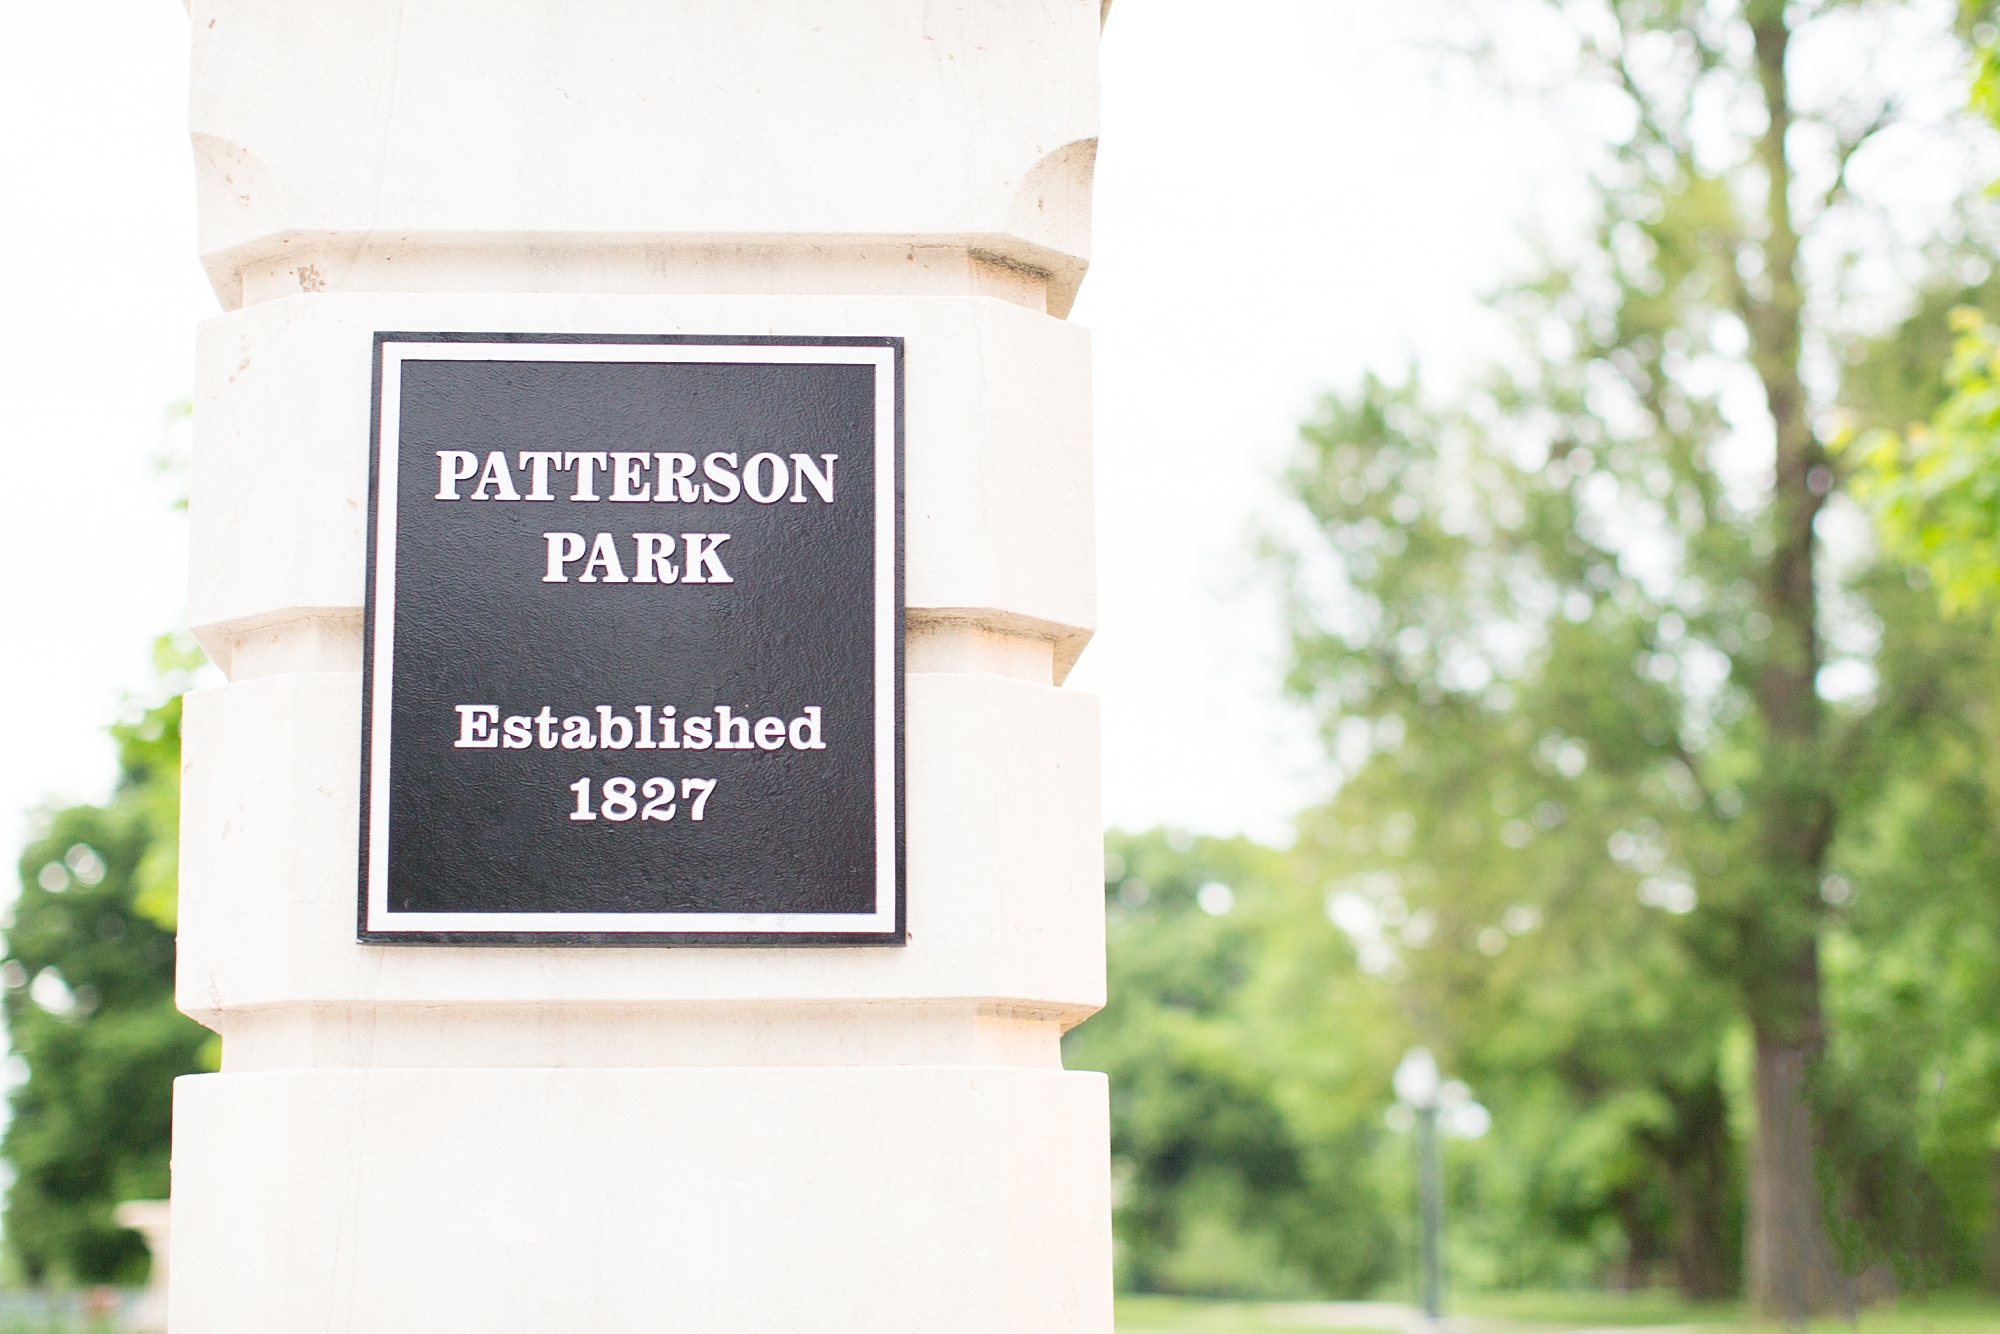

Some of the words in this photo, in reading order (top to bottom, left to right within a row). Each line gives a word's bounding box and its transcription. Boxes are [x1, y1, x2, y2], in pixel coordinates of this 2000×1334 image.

[435, 450, 838, 503] PATTERSON
[542, 532, 734, 584] PARK
[454, 704, 826, 750] Established
[569, 777, 717, 821] 1827
